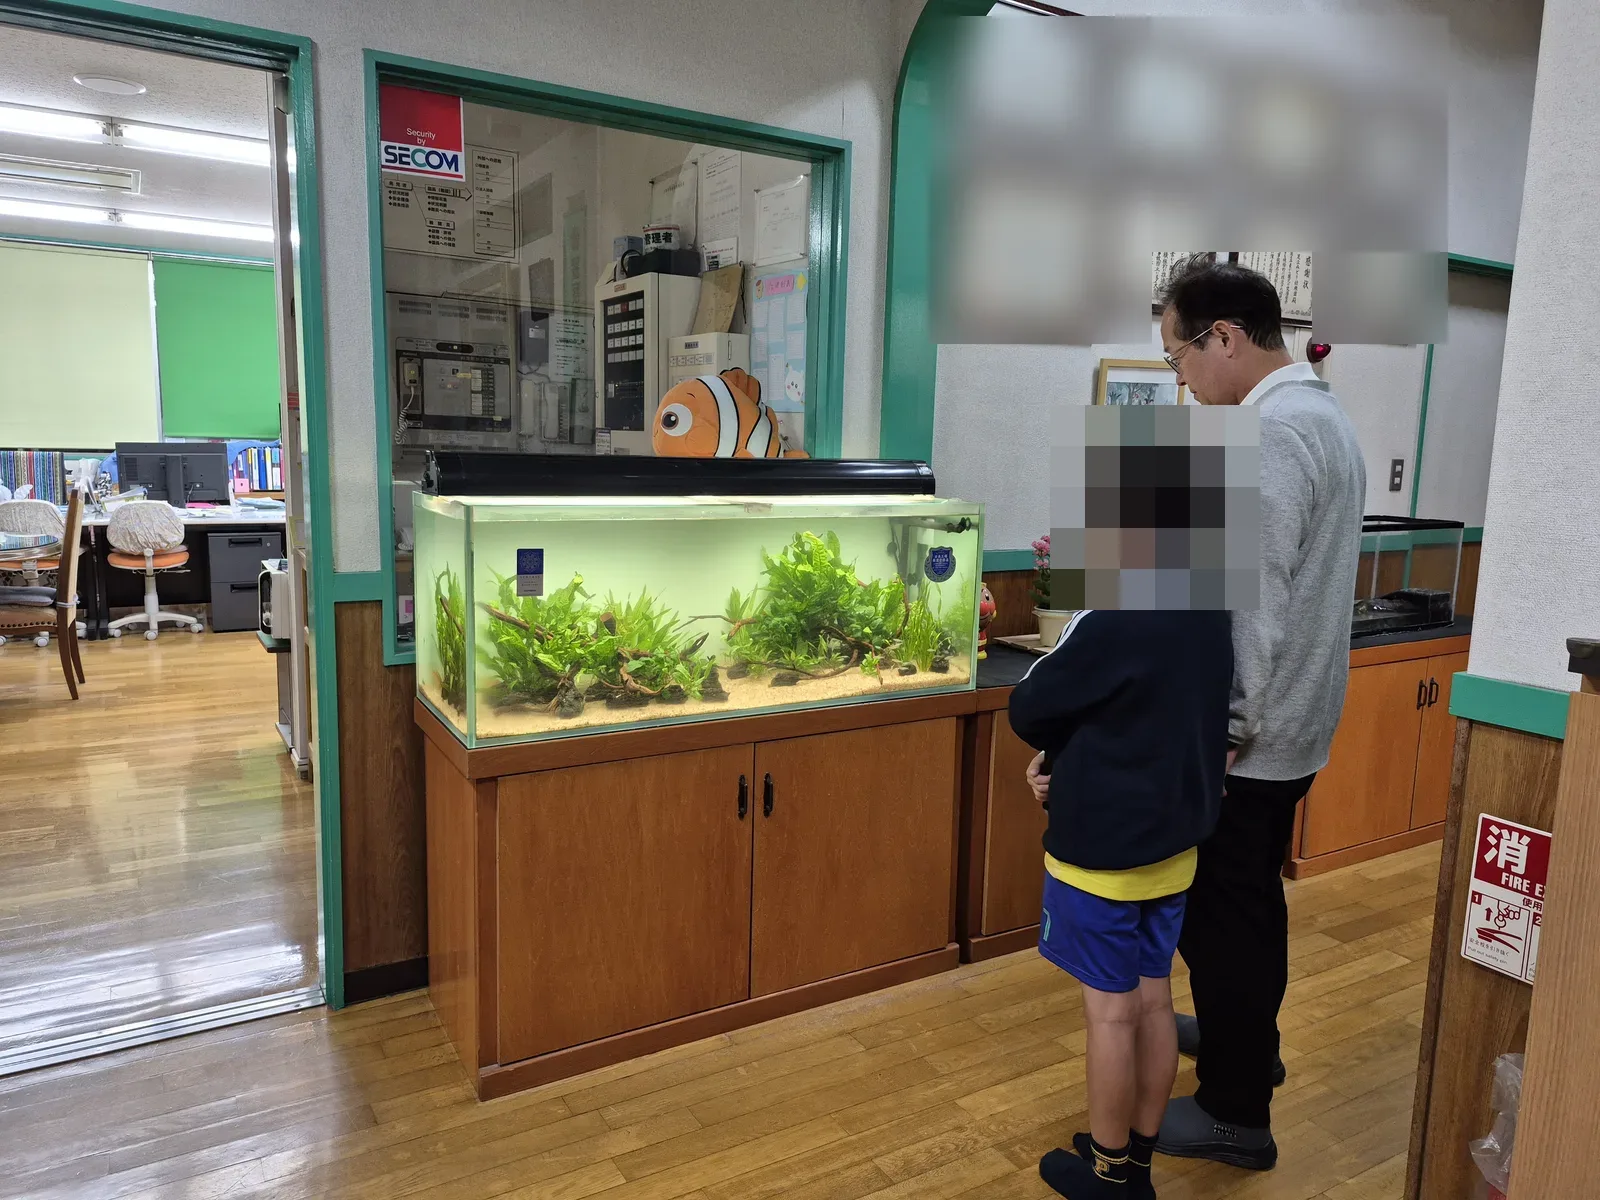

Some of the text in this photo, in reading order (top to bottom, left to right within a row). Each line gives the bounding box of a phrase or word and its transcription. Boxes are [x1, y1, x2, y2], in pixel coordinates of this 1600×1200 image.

[406, 127, 436, 140] Security
[416, 138, 426, 146] by
[384, 144, 459, 172] SECOM
[644, 231, 673, 245] 管理者
[1484, 825, 1531, 875] 消
[1501, 871, 1531, 893] FIRE
[1473, 894, 1480, 903] 1
[1523, 897, 1543, 912] 使用
[1534, 915, 1542, 926] 2
